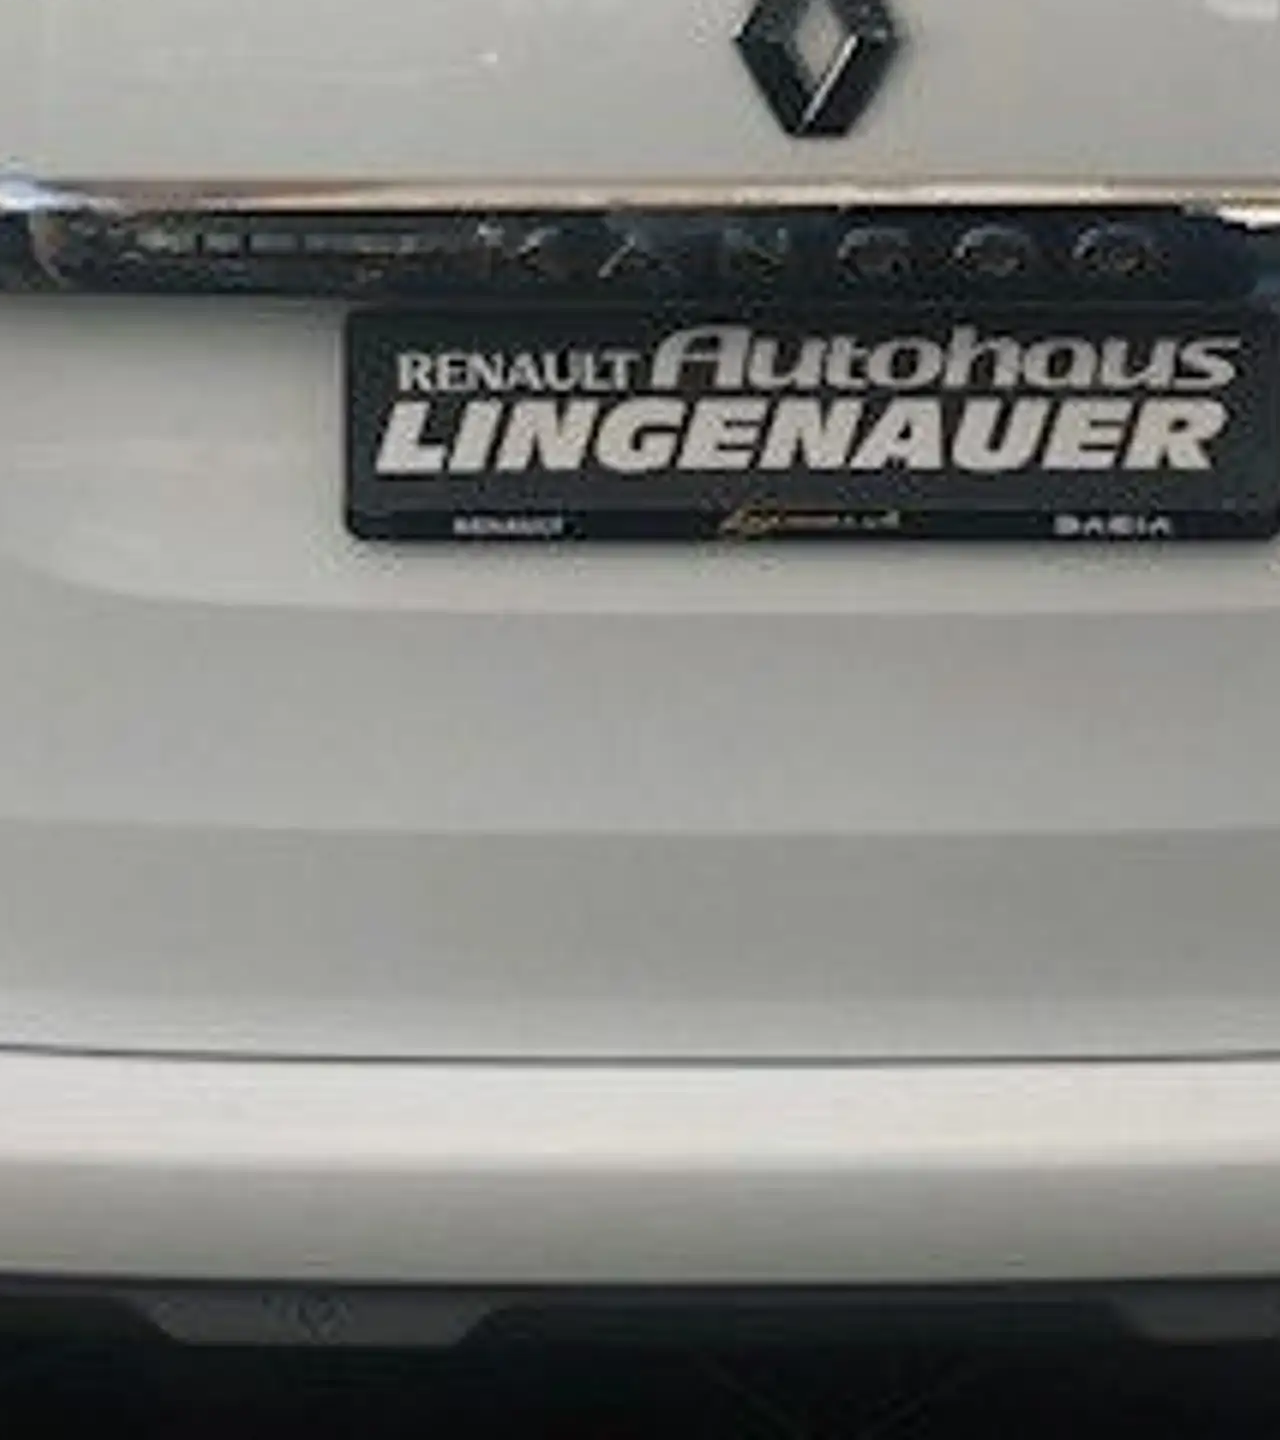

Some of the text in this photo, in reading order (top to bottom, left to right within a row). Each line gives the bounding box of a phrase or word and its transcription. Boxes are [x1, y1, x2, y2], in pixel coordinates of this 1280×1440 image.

[398, 324, 1242, 392] RENAULT Autohaus
[375, 396, 1230, 474] LINGENAUER
